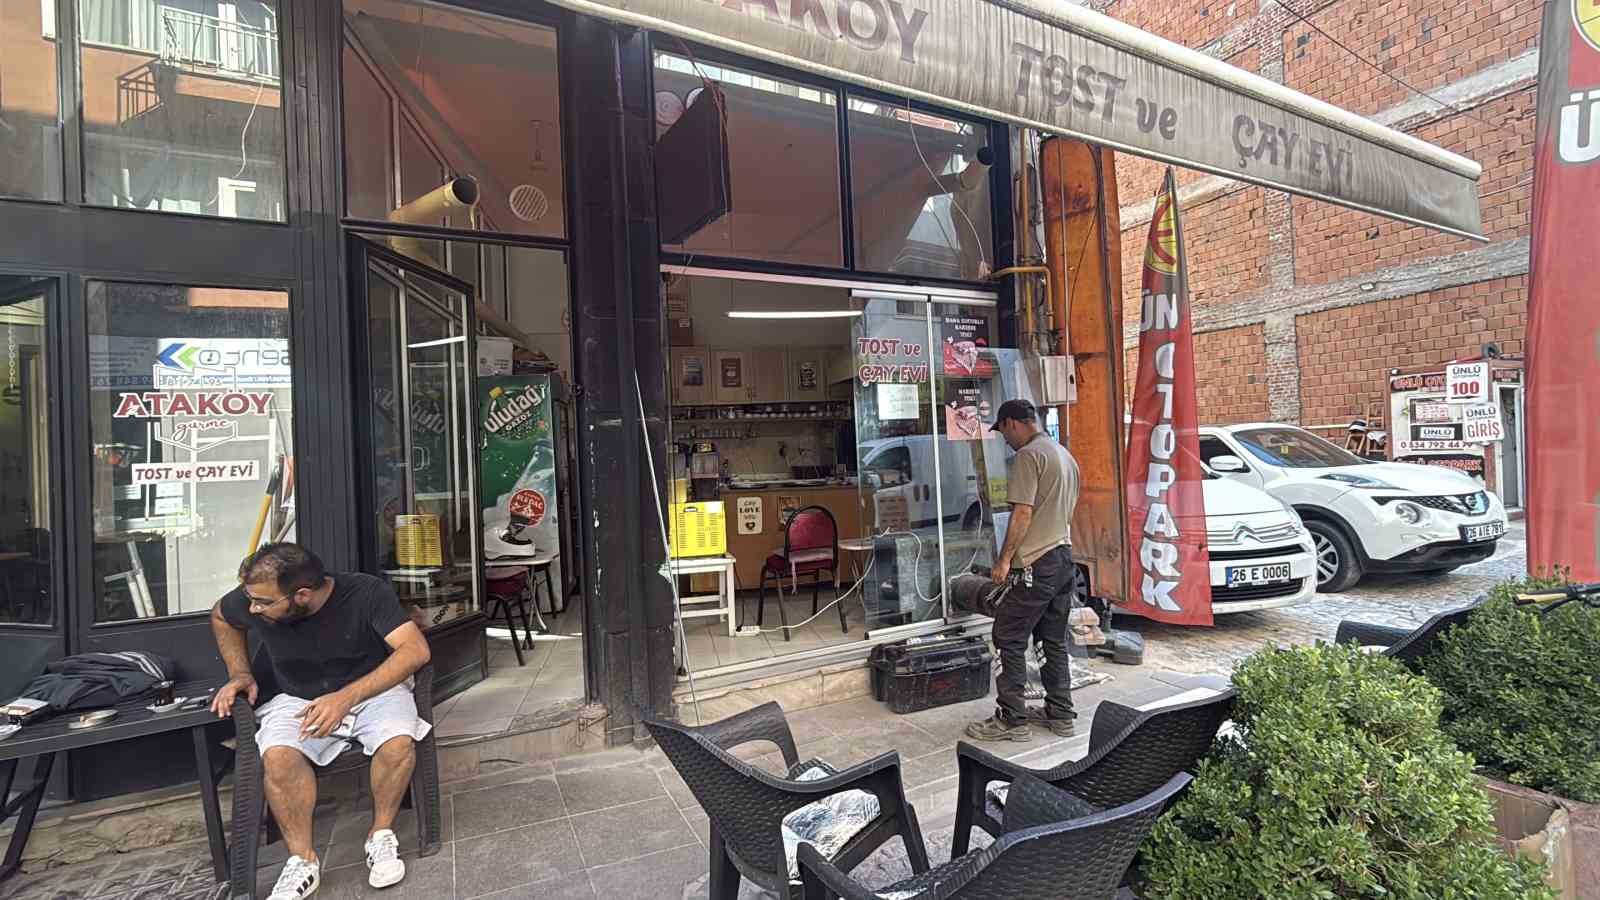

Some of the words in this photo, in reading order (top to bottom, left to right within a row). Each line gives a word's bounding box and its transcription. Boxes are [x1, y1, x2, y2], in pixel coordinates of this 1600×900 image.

[1012, 42, 1127, 123] TOST
[1136, 97, 1178, 141] ve
[1232, 114, 1300, 170] ÇAY
[1309, 138, 1353, 196] EVİ
[857, 337, 901, 357] TOST
[904, 343, 921, 357] ve
[858, 364, 896, 388] ÇAY
[899, 361, 929, 384] EVİ
[1453, 364, 1481, 375] ÜNLÜ
[1451, 381, 1480, 395] 100
[113, 388, 274, 418] ATAKÖY
[483, 384, 543, 433] uludağ
[1466, 406, 1496, 418] ÜNLÜ
[172, 419, 228, 441] gurme
[1467, 420, 1500, 438] GİRİŞ
[1400, 441, 1407, 449] 0
[1428, 440, 1445, 449] 792
[135, 466, 172, 480] TOST
[176, 468, 192, 480] ve
[195, 465, 226, 481] ÇAY
[230, 461, 254, 477] EVİ
[1232, 569, 1247, 582] 26
[1251, 567, 1260, 580] E
[1262, 565, 1289, 579] 0006
